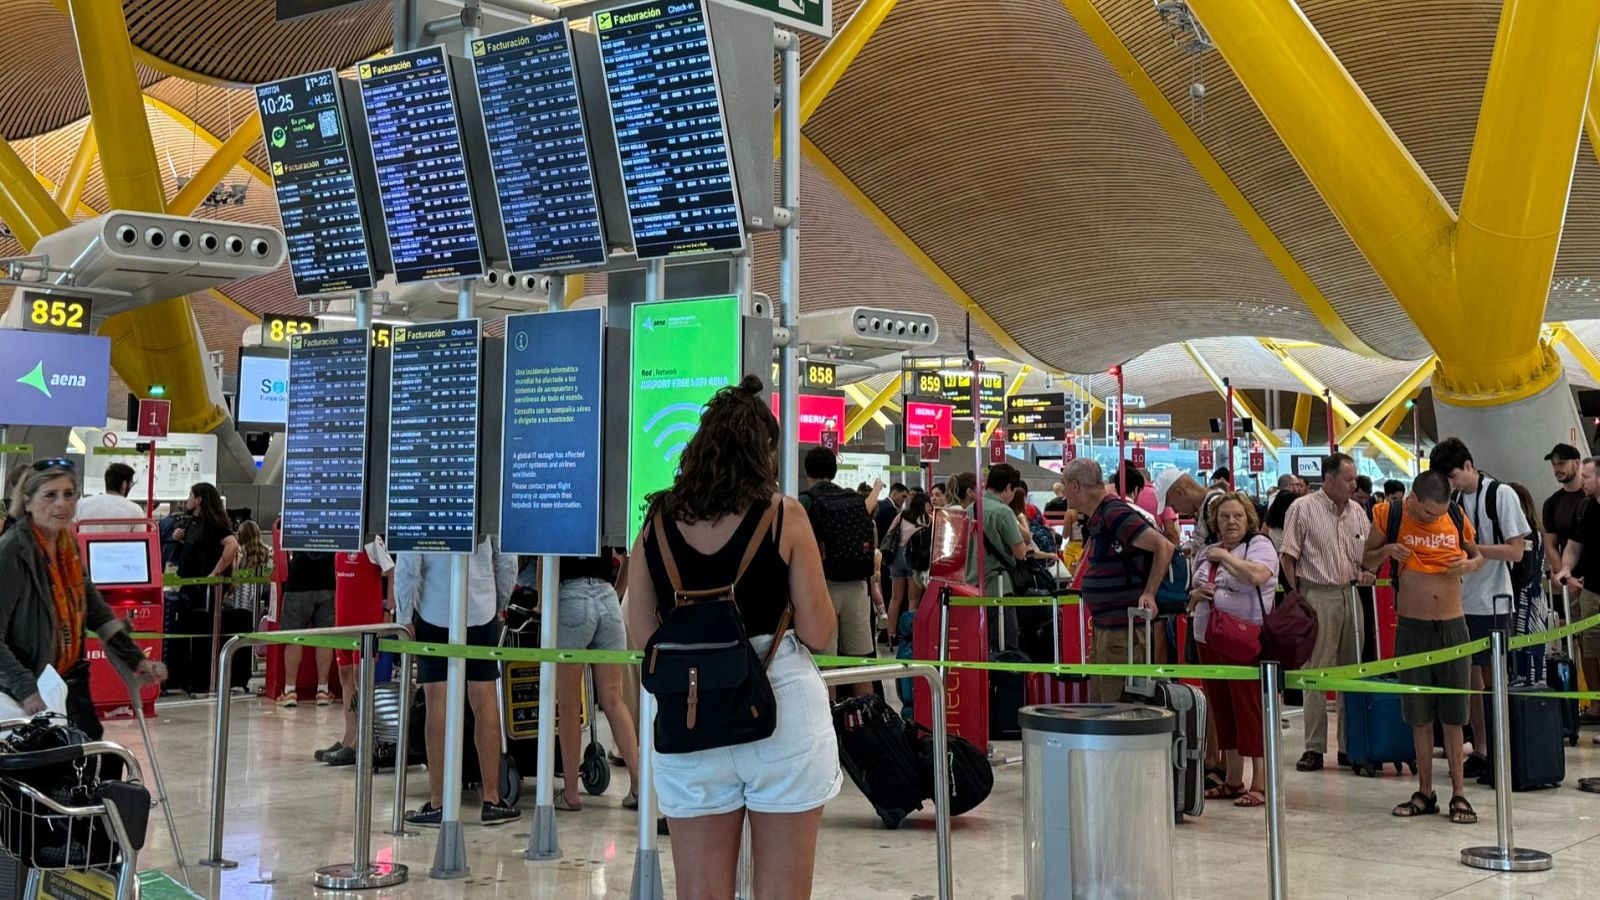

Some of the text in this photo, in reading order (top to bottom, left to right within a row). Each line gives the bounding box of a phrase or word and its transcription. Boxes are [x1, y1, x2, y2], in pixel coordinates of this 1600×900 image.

[613, 0, 694, 24] Facturación Check-in
[486, 30, 559, 52] Facturación Check-in
[372, 59, 411, 75] Facturación
[260, 93, 294, 115] 10:25
[284, 159, 319, 172] Facturación
[32, 299, 84, 328] 852
[407, 328, 445, 339] Facturación
[303, 336, 337, 346] Facturación
[550, 365, 578, 373] informática
[656, 368, 678, 376] Network
[809, 366, 833, 384] 858
[50, 374, 86, 387] aena
[640, 379, 671, 390] AIRPORT
[673, 378, 690, 388] FREE
[920, 376, 941, 392] 859
[544, 385, 573, 393] aeropuertos
[915, 408, 936, 416] IBERIA
[149, 412, 158, 426] 1
[926, 443, 934, 452] 7
[994, 447, 1001, 456] 8
[517, 452, 530, 460] global
[1133, 454, 1144, 463] 10
[1200, 456, 1211, 464] 11
[1252, 457, 1262, 466] 12
[557, 481, 570, 489] flight
[511, 501, 532, 509] helpdesk
